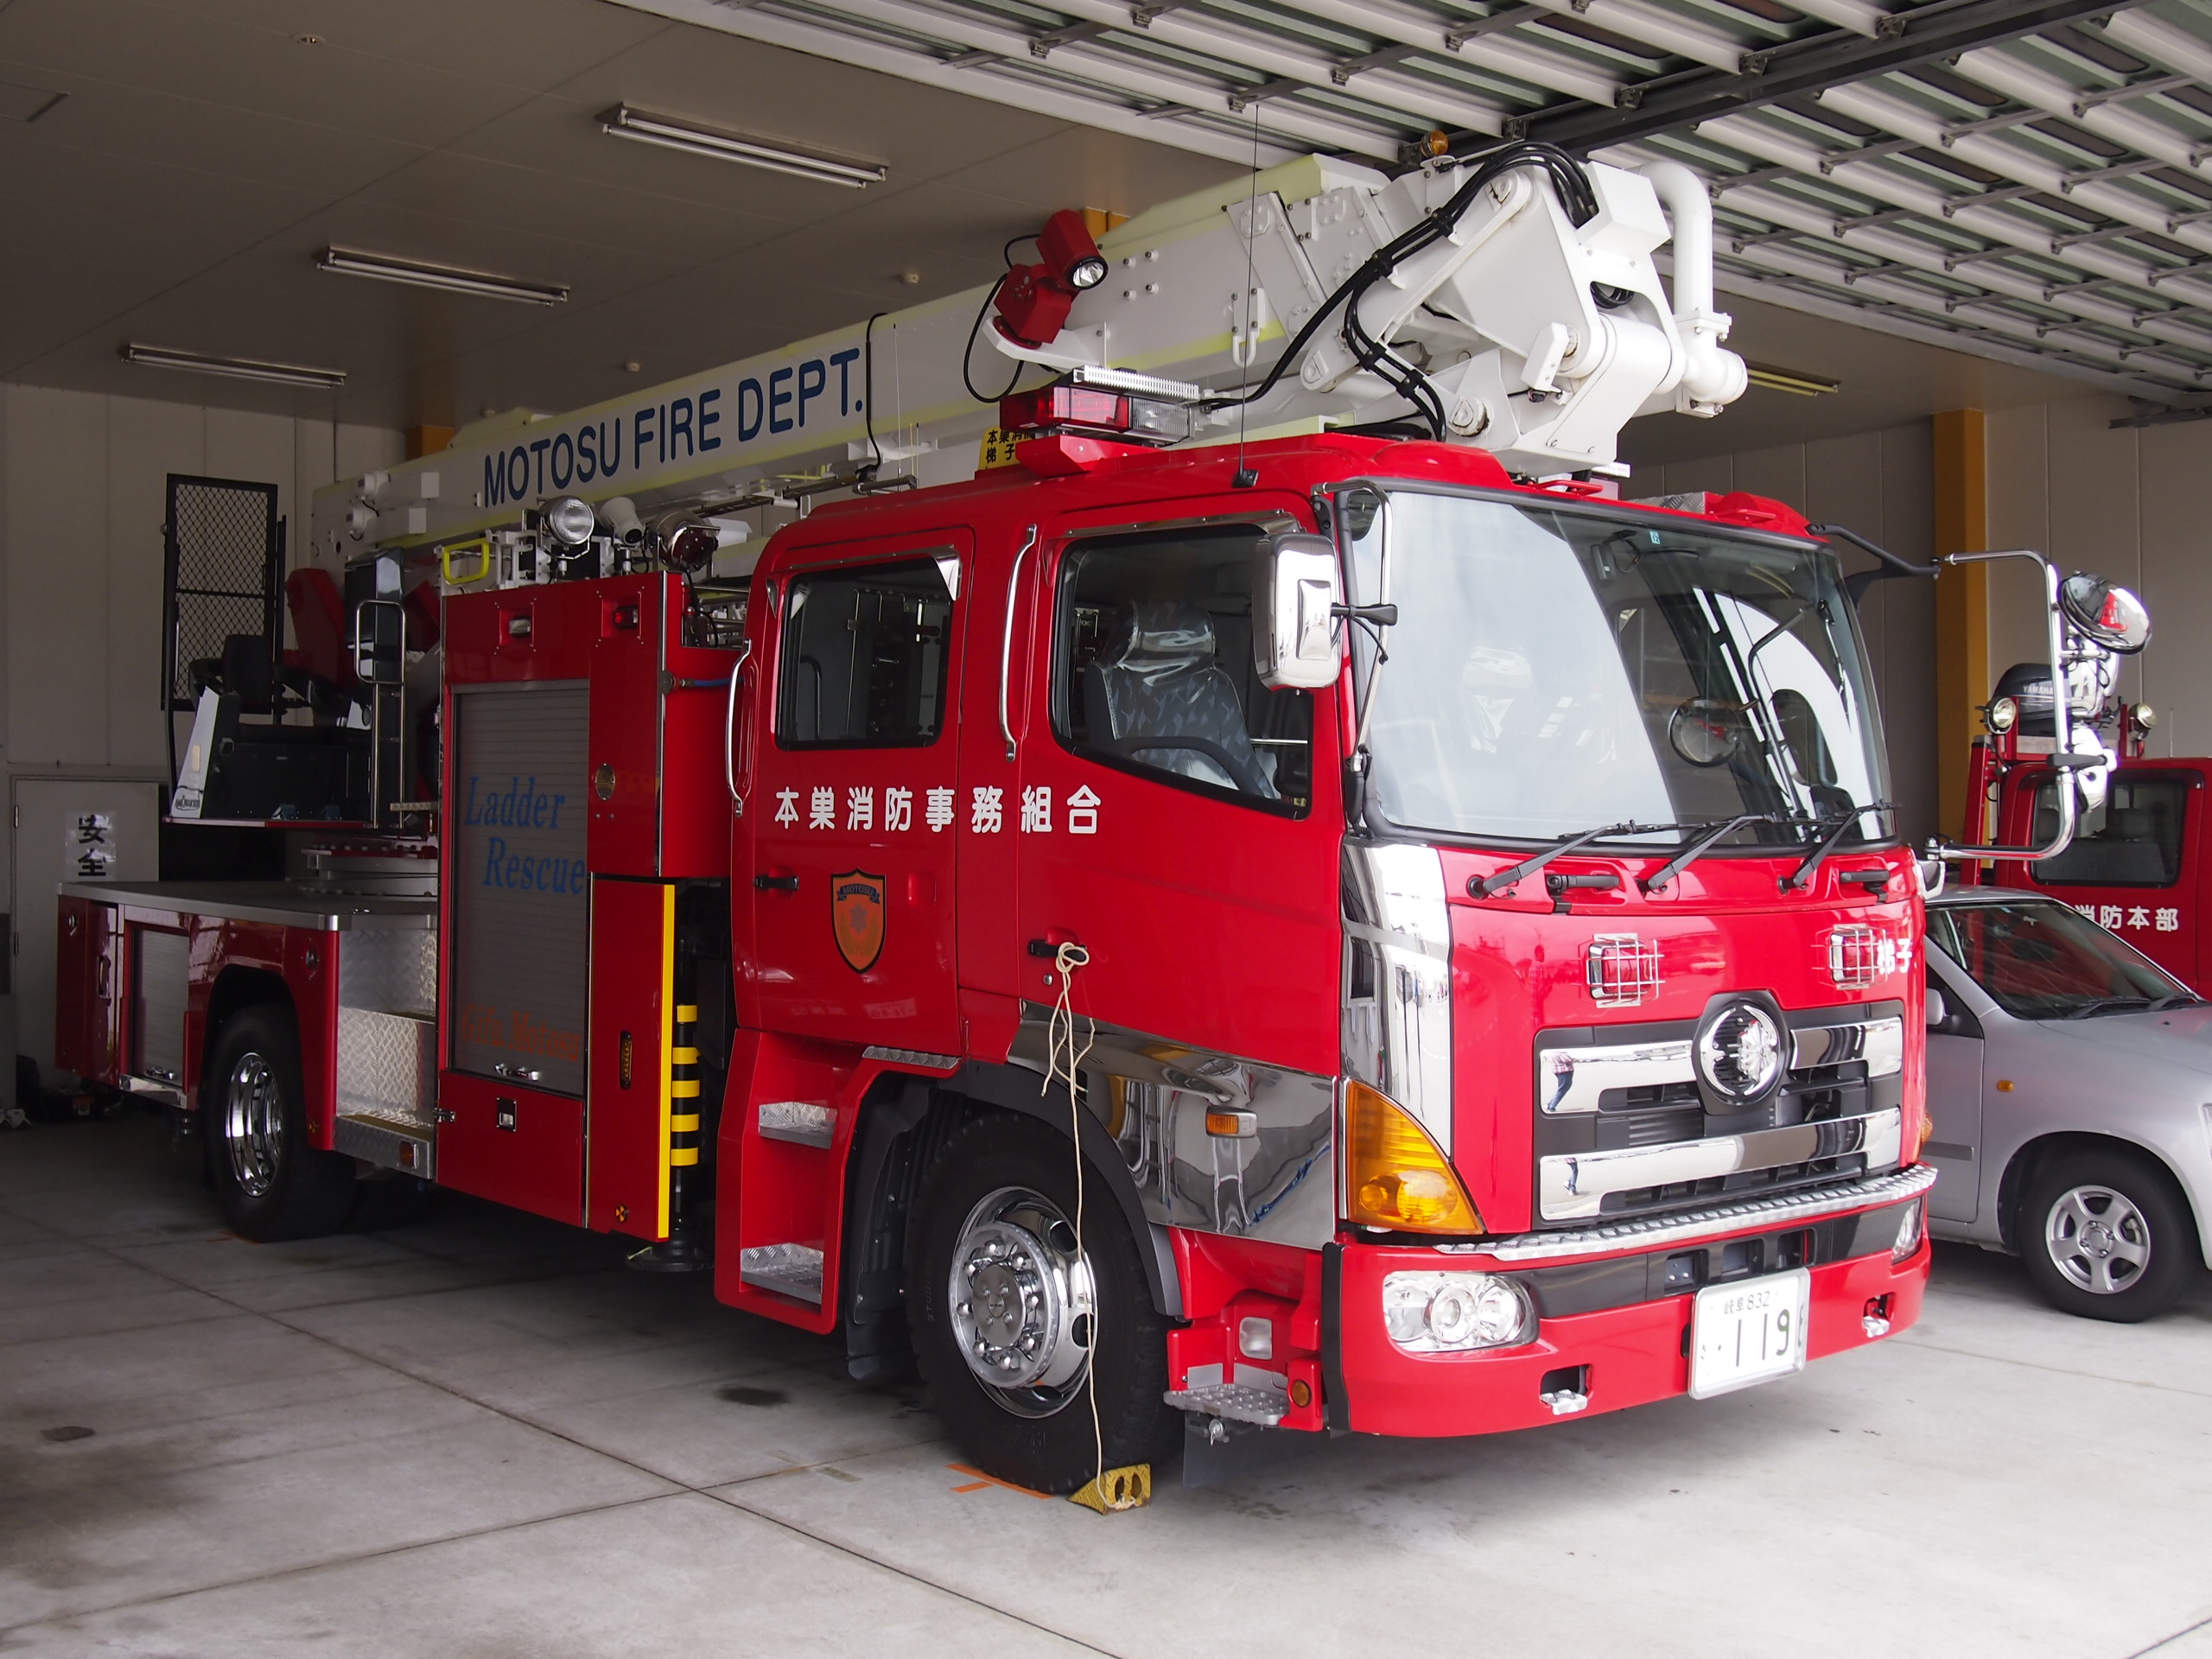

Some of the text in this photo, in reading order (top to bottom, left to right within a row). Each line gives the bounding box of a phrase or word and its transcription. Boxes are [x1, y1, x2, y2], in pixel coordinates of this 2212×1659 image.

[485, 348, 862, 508] MOTOSU FIRE DEPT.
[464, 776, 565, 828] Ladder
[775, 785, 1101, 834] 本巣消防事務組合
[78, 814, 108, 876] 安全
[483, 836, 586, 894] Rescue
[842, 885, 874, 895] MOTOSU
